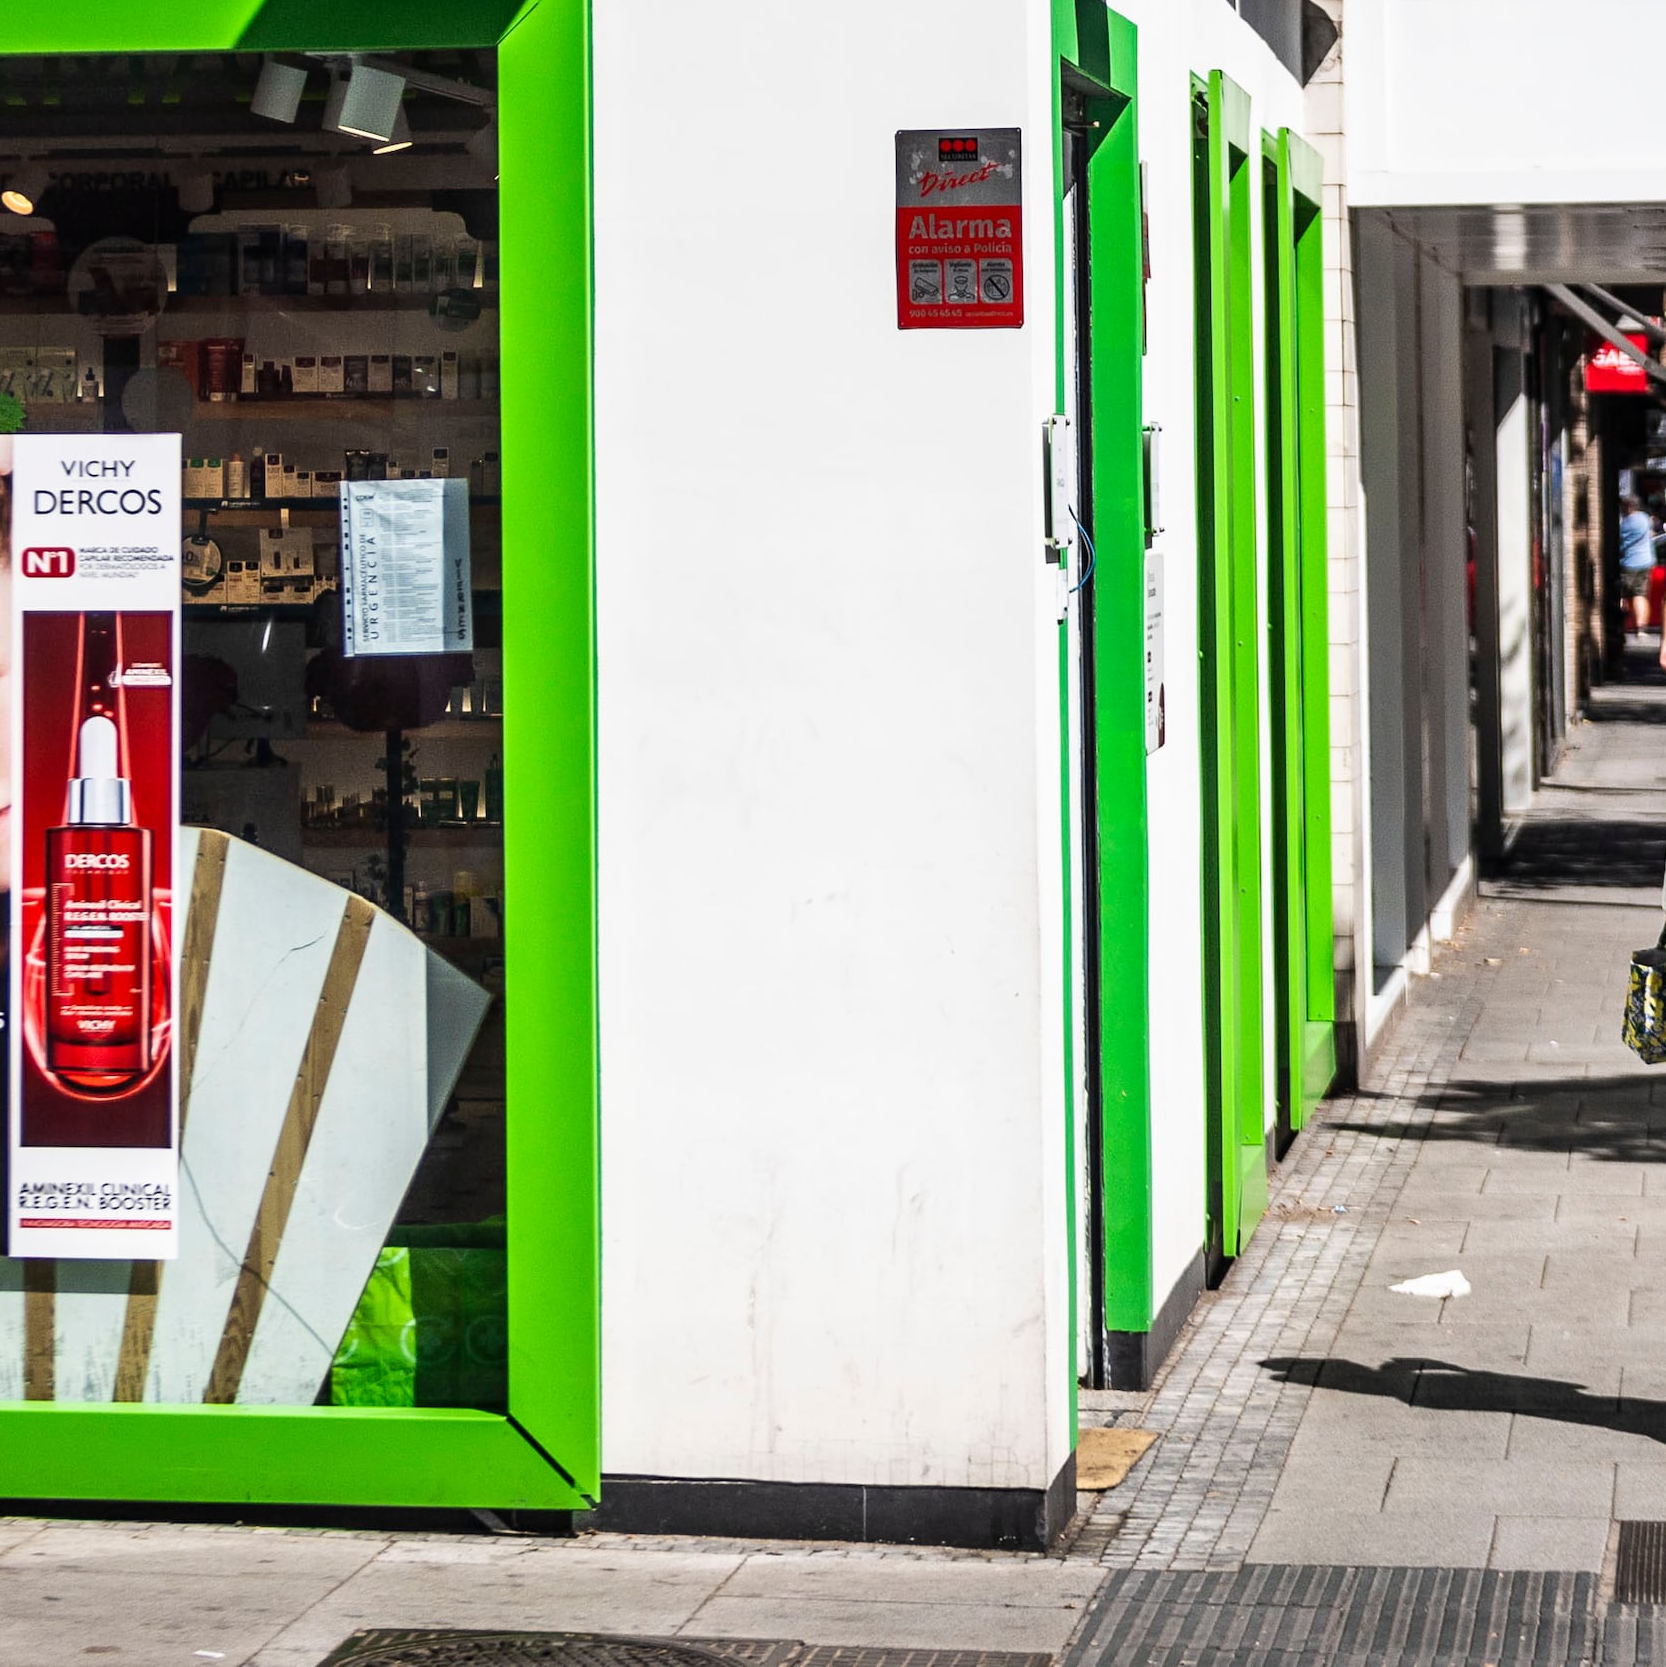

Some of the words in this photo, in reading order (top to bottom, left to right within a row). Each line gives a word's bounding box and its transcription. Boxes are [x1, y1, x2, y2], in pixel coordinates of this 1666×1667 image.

[917, 162, 1002, 198] Direct
[908, 214, 1012, 239] Alarma
[908, 245, 929, 254] con
[932, 242, 961, 254] aviso
[963, 244, 971, 254] a
[974, 241, 1013, 254] Policía
[60, 460, 136, 477] VICHY
[34, 489, 162, 515] DERCOS
[367, 536, 380, 640] URGENCIA
[65, 854, 130, 869] DERCOS
[77, 1020, 116, 1031] VICHY
[19, 1182, 97, 1196] AMINEXIL
[101, 1182, 172, 1197] CLINICAL
[98, 1196, 172, 1211] BOOSTER
